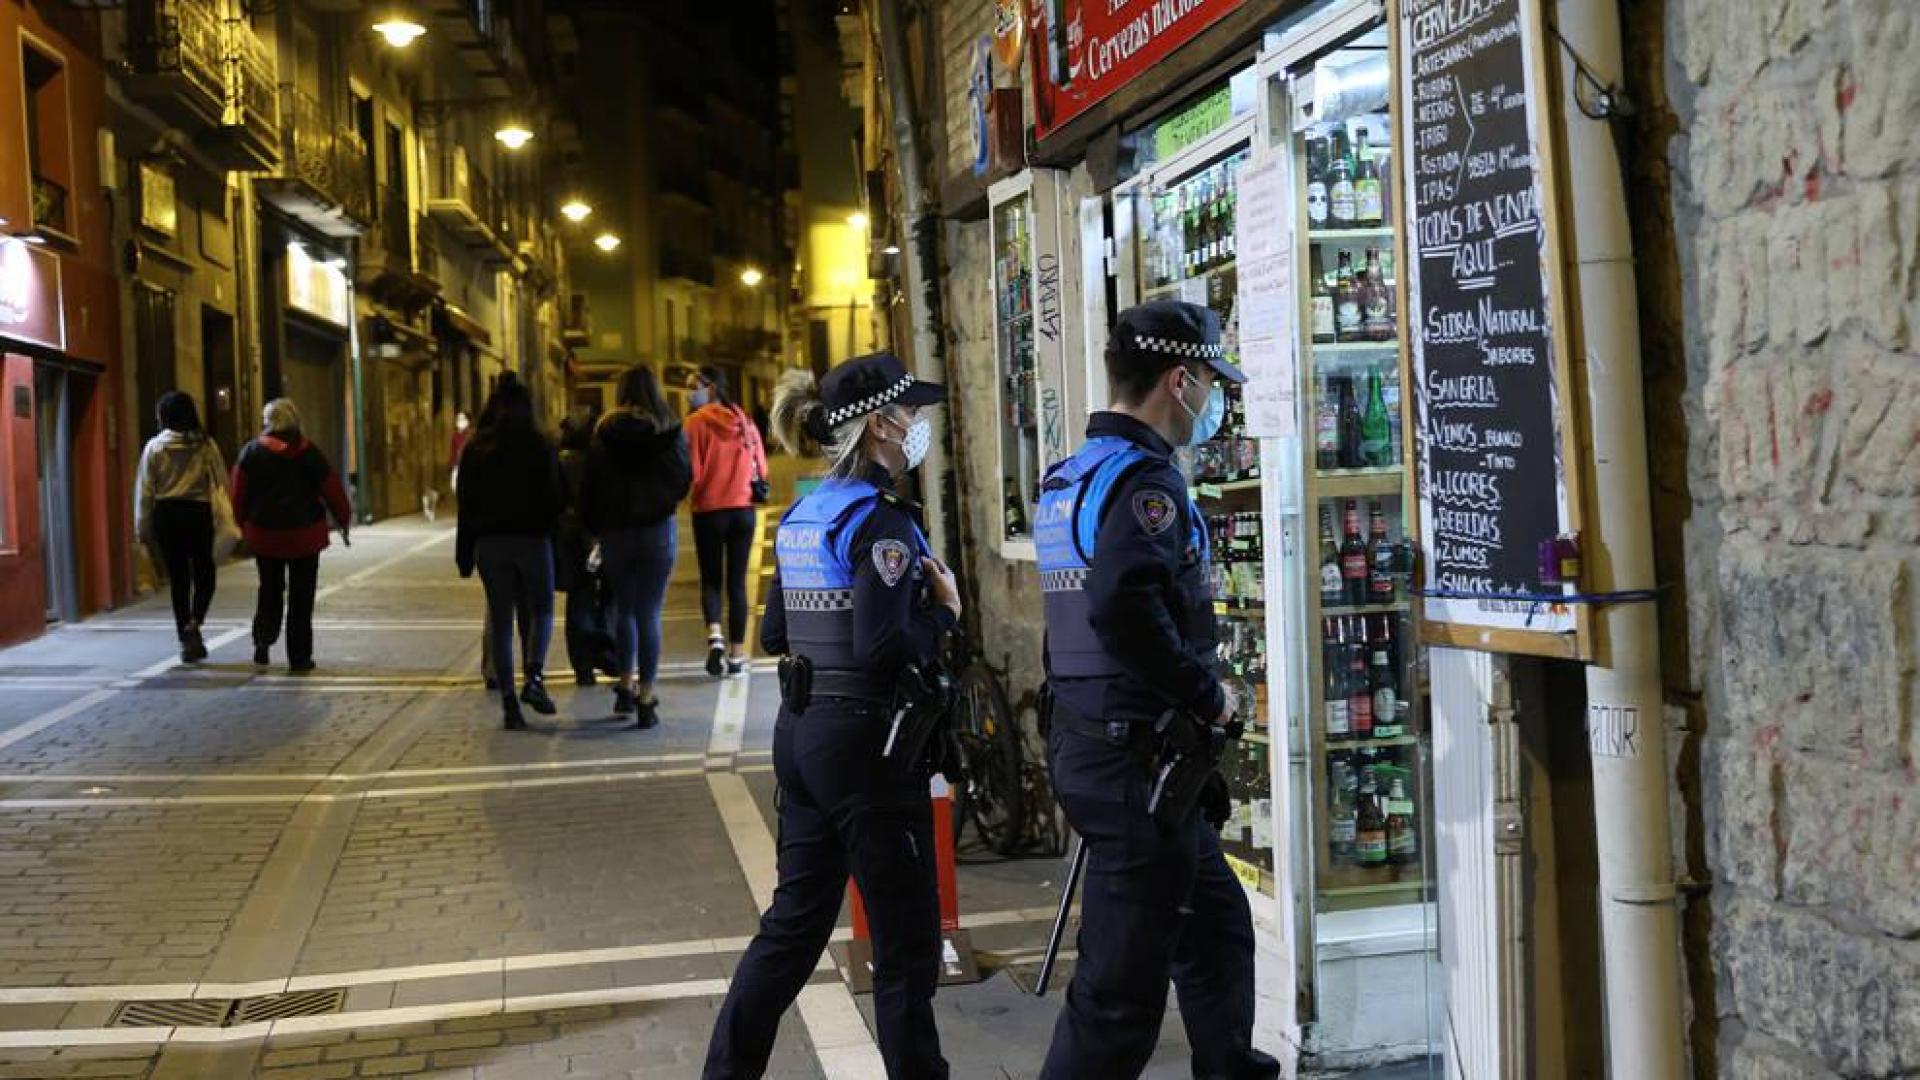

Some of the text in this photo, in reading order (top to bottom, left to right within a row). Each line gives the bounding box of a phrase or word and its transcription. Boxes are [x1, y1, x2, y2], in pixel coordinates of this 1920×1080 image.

[1088, 11, 1150, 80] Cervezas
[1423, 177, 1454, 204] IPAS
[1418, 206, 1463, 247] TODAS
[1464, 202, 1484, 233] DE
[1429, 296, 1540, 339] SIDRA NATURAL
[1481, 341, 1536, 367] SABORES
[1428, 370, 1500, 402] SANGRIA
[1431, 416, 1477, 447] VINOS
[1436, 471, 1499, 503] LICORES
[1438, 507, 1500, 542] BEBIDAS
[1441, 542, 1487, 564] ZUMOS
